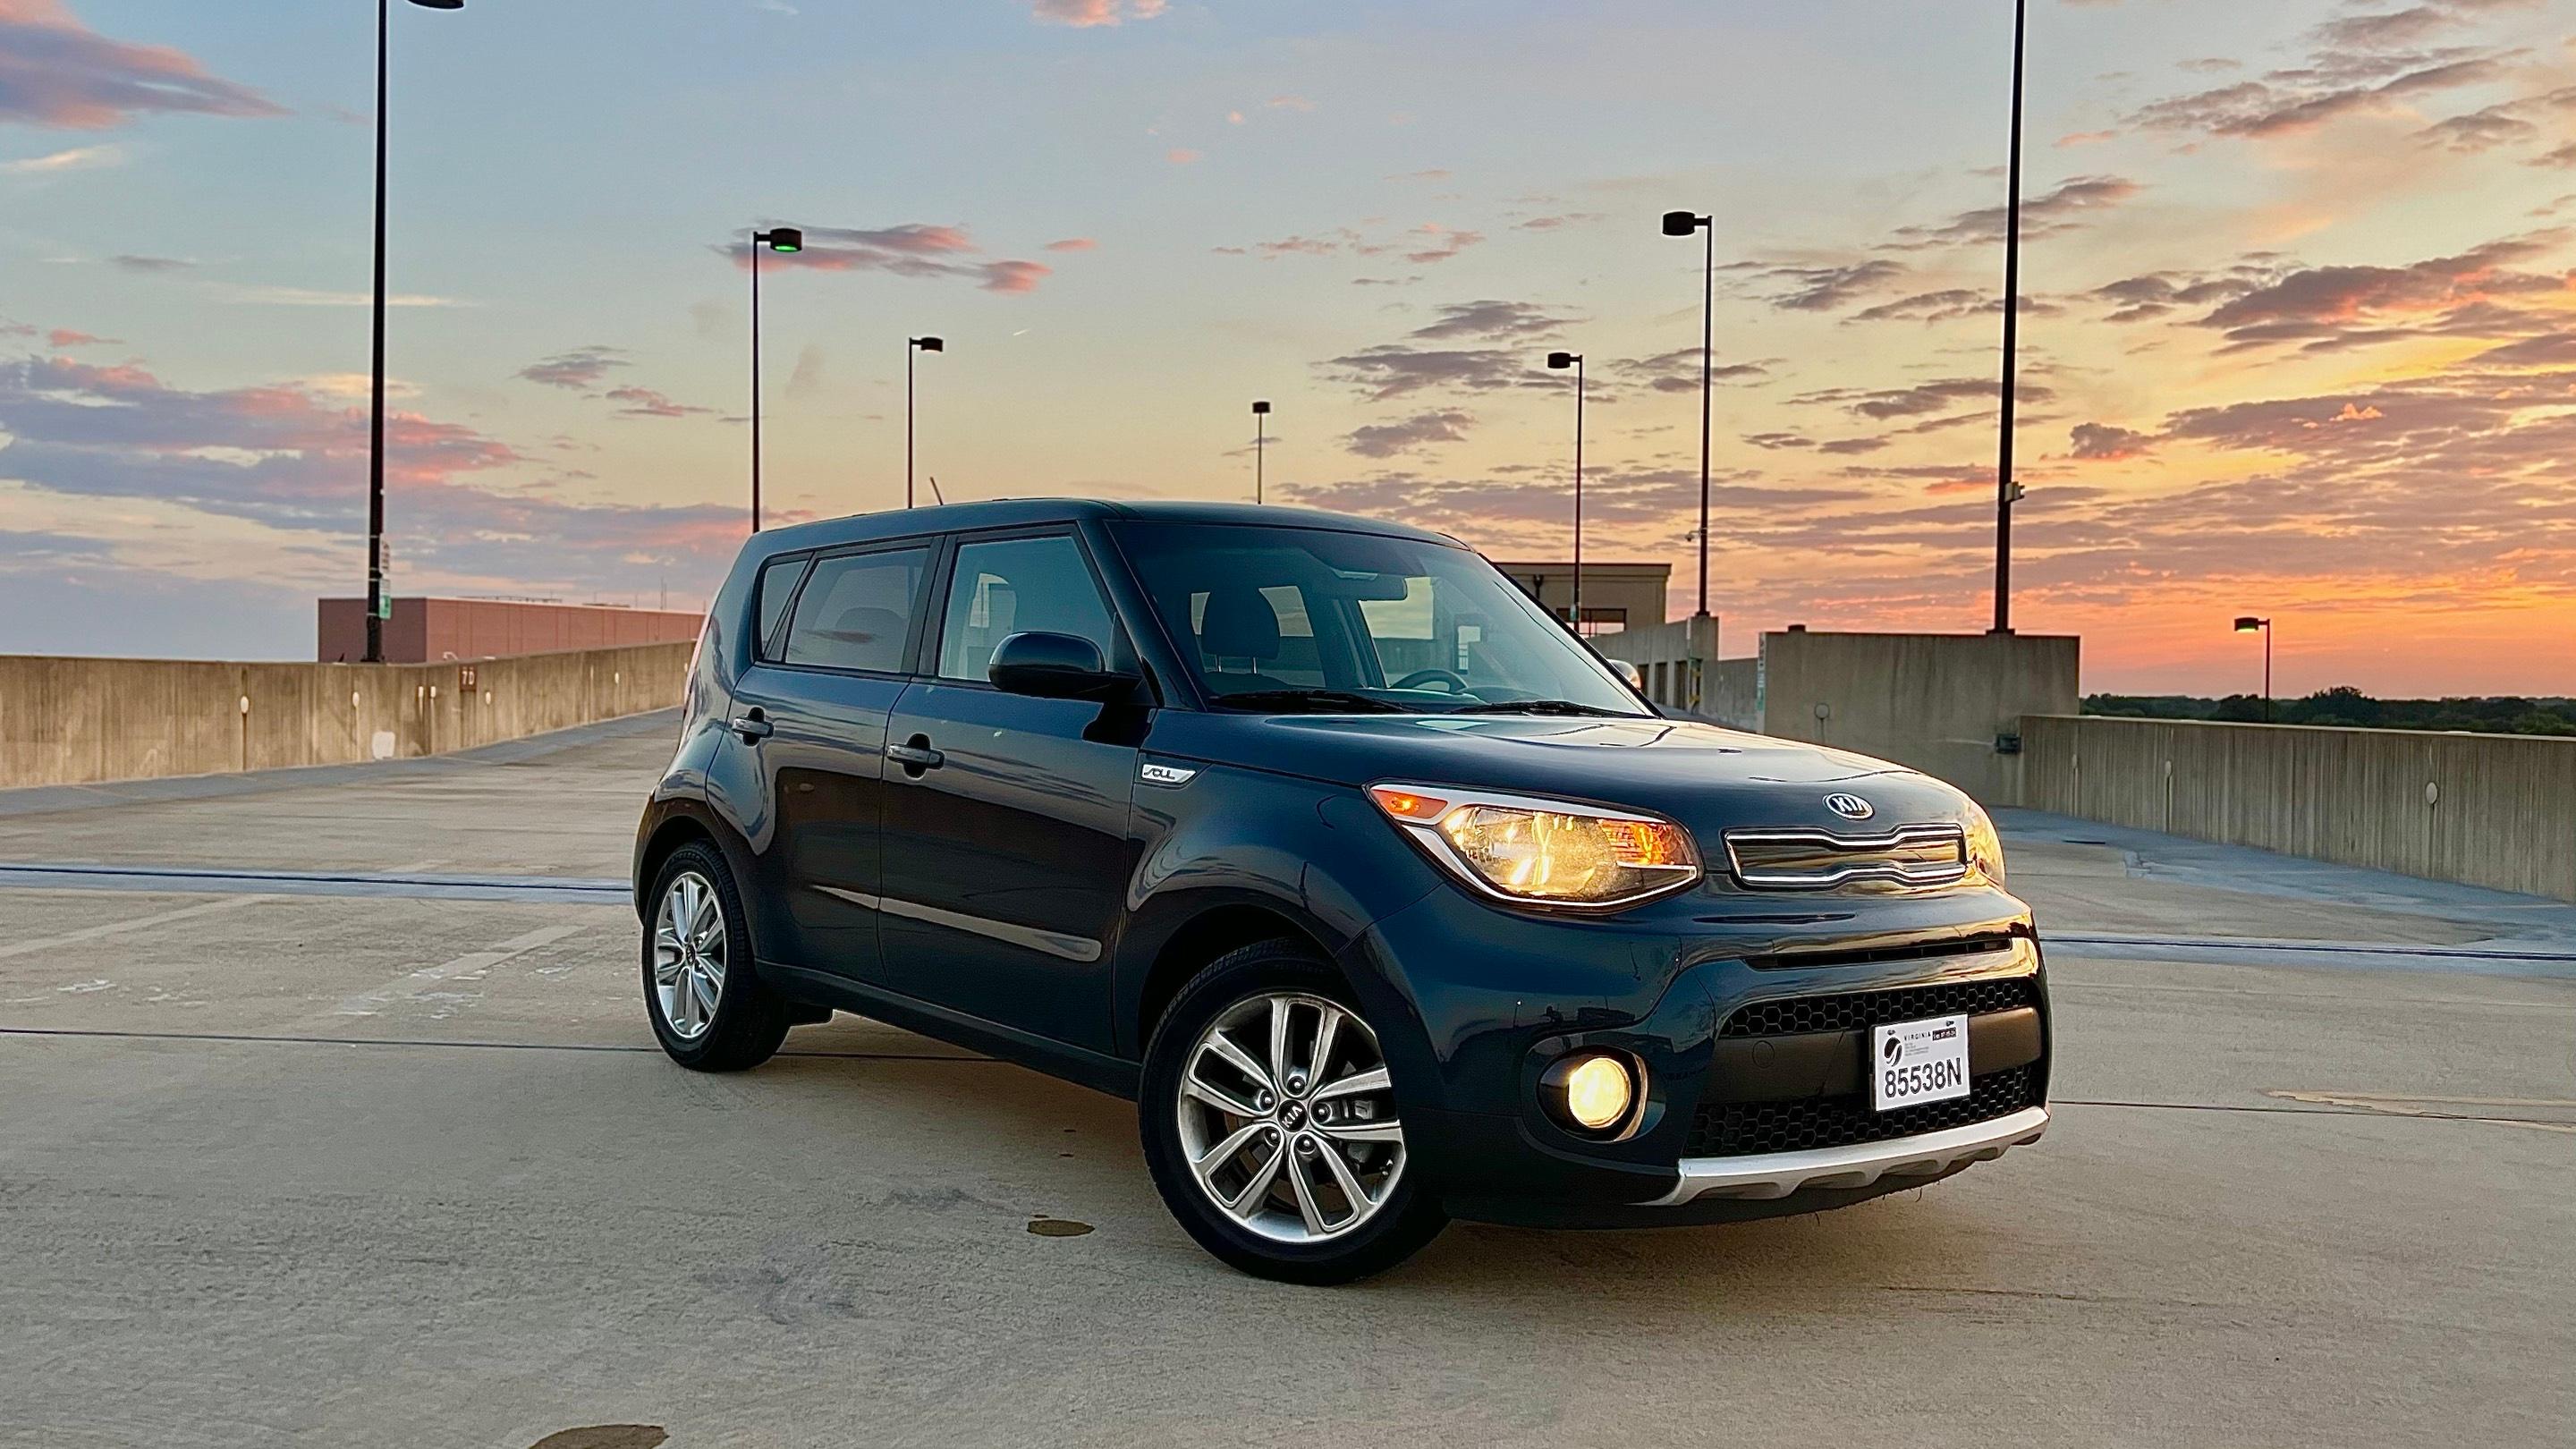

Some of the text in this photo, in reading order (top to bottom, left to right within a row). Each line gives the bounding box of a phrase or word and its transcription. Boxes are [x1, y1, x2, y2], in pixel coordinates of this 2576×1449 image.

[1831, 796, 1871, 812] KIA
[1904, 1031, 1931, 1041] VIRGINIA
[1885, 1057, 1962, 1098] 85538N
[1282, 1106, 1302, 1128] KIA
